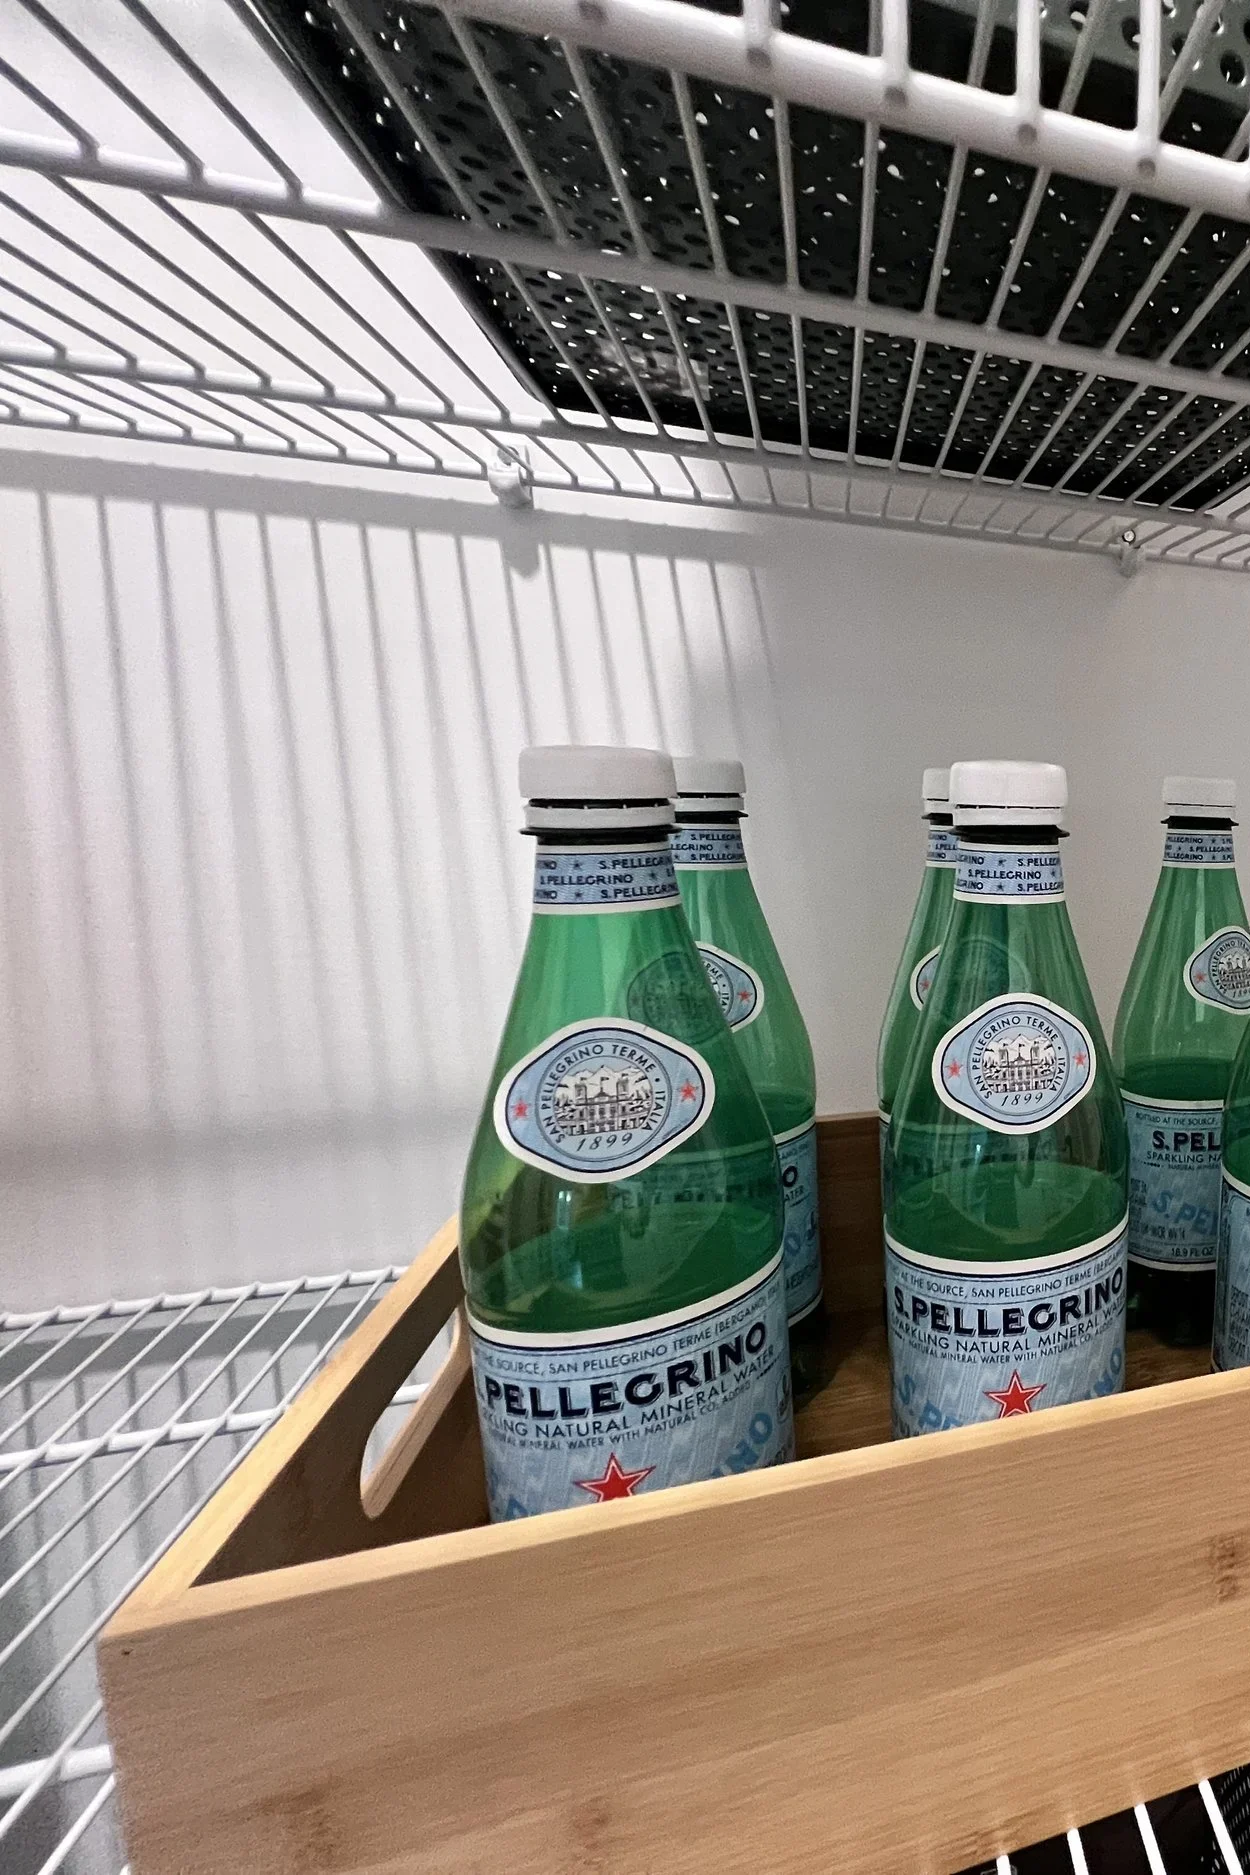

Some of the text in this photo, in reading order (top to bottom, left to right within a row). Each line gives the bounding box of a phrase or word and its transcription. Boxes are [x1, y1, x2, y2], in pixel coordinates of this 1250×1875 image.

[972, 1015, 1066, 1100] SAN PELLEGRINO TERME ITALIA
[541, 1044, 666, 1144] SAN PELLEGRINO TERME ITALIA
[1001, 1092, 1044, 1107] 1899
[576, 1132, 633, 1152] 1899
[1146, 1150, 1204, 1164] SPARKLING
[971, 1287, 995, 1299] SAN
[998, 1279, 1063, 1299] PELLEGRINO
[1064, 1266, 1092, 1287] TERME
[893, 1266, 1124, 1341] S.PELLEGRINO
[548, 1361, 578, 1376] SAN
[583, 1344, 668, 1373] PELLEGRINO
[673, 1325, 712, 1352] TERME
[956, 1337, 1031, 1354] NATURAL
[1037, 1315, 1099, 1348] MINERAL
[940, 1351, 977, 1364] MINERAL
[980, 1354, 1011, 1365] WATER
[1013, 1351, 1038, 1362] WITH
[1040, 1342, 1078, 1358] NATURAL
[535, 1415, 632, 1439] NATURAL
[640, 1379, 729, 1426] MINERAL
[733, 1343, 775, 1384] WATER
[608, 1430, 641, 1445] WITH
[644, 1413, 698, 1436] NATURAL
